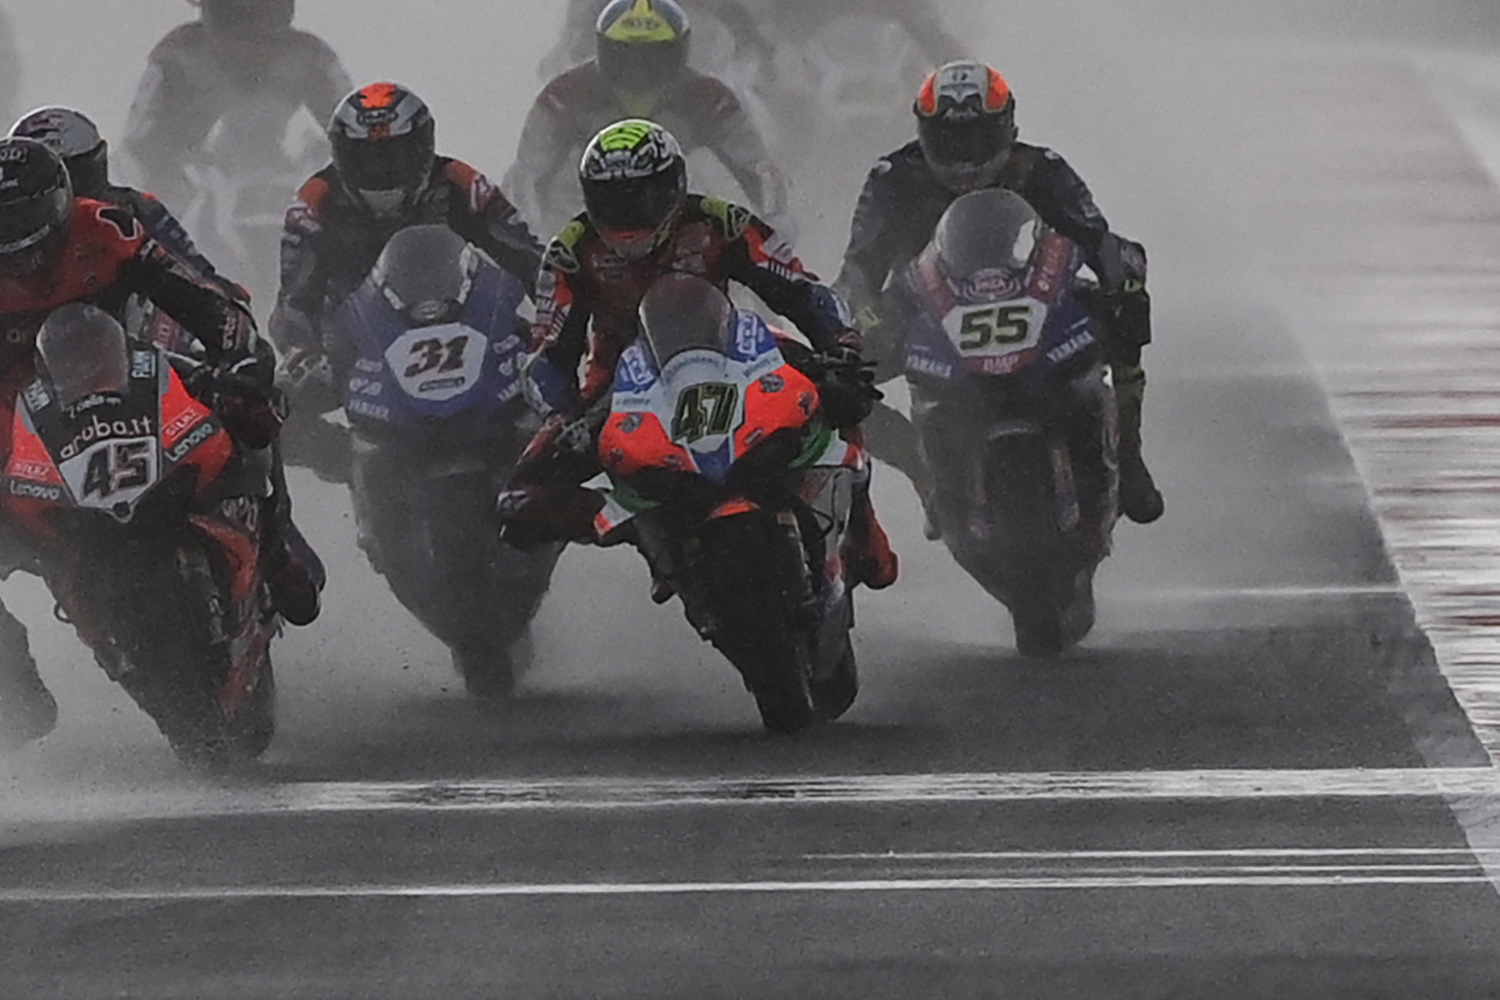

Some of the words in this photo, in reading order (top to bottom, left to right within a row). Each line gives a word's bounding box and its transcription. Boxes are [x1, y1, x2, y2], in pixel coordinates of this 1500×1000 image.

[960, 305, 1029, 351] 55
[403, 335, 469, 377] 31
[670, 381, 740, 443] 47
[59, 415, 152, 459] aruba.it
[165, 423, 213, 462] Lenovo
[10, 480, 60, 500] Lenovo
[83, 440, 151, 499] 45
